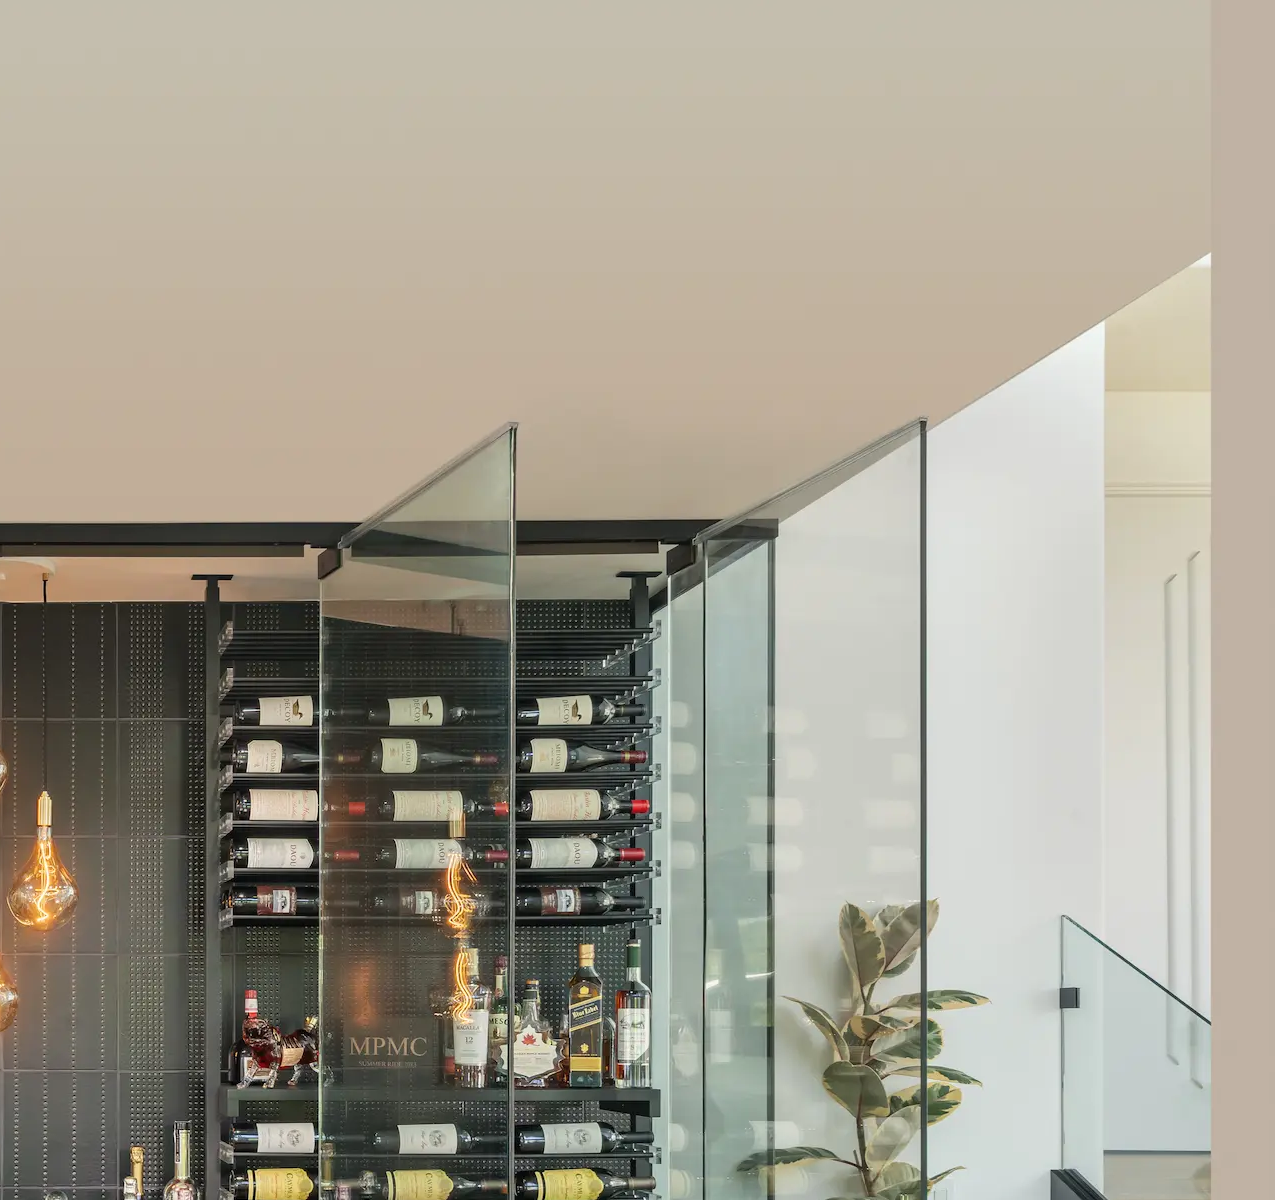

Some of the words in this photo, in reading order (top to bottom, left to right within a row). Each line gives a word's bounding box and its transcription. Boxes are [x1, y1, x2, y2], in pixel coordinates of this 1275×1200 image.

[283, 698, 291, 723] DECOY
[562, 699, 570, 724] DECOY
[289, 844, 297, 867] DAOU
[573, 842, 581, 865] DAOU
[349, 1036, 428, 1057] MPMC
[465, 1036, 474, 1044] 12
[285, 1172, 293, 1199] CAYMUS
[425, 1172, 433, 1198] CAYMUS
